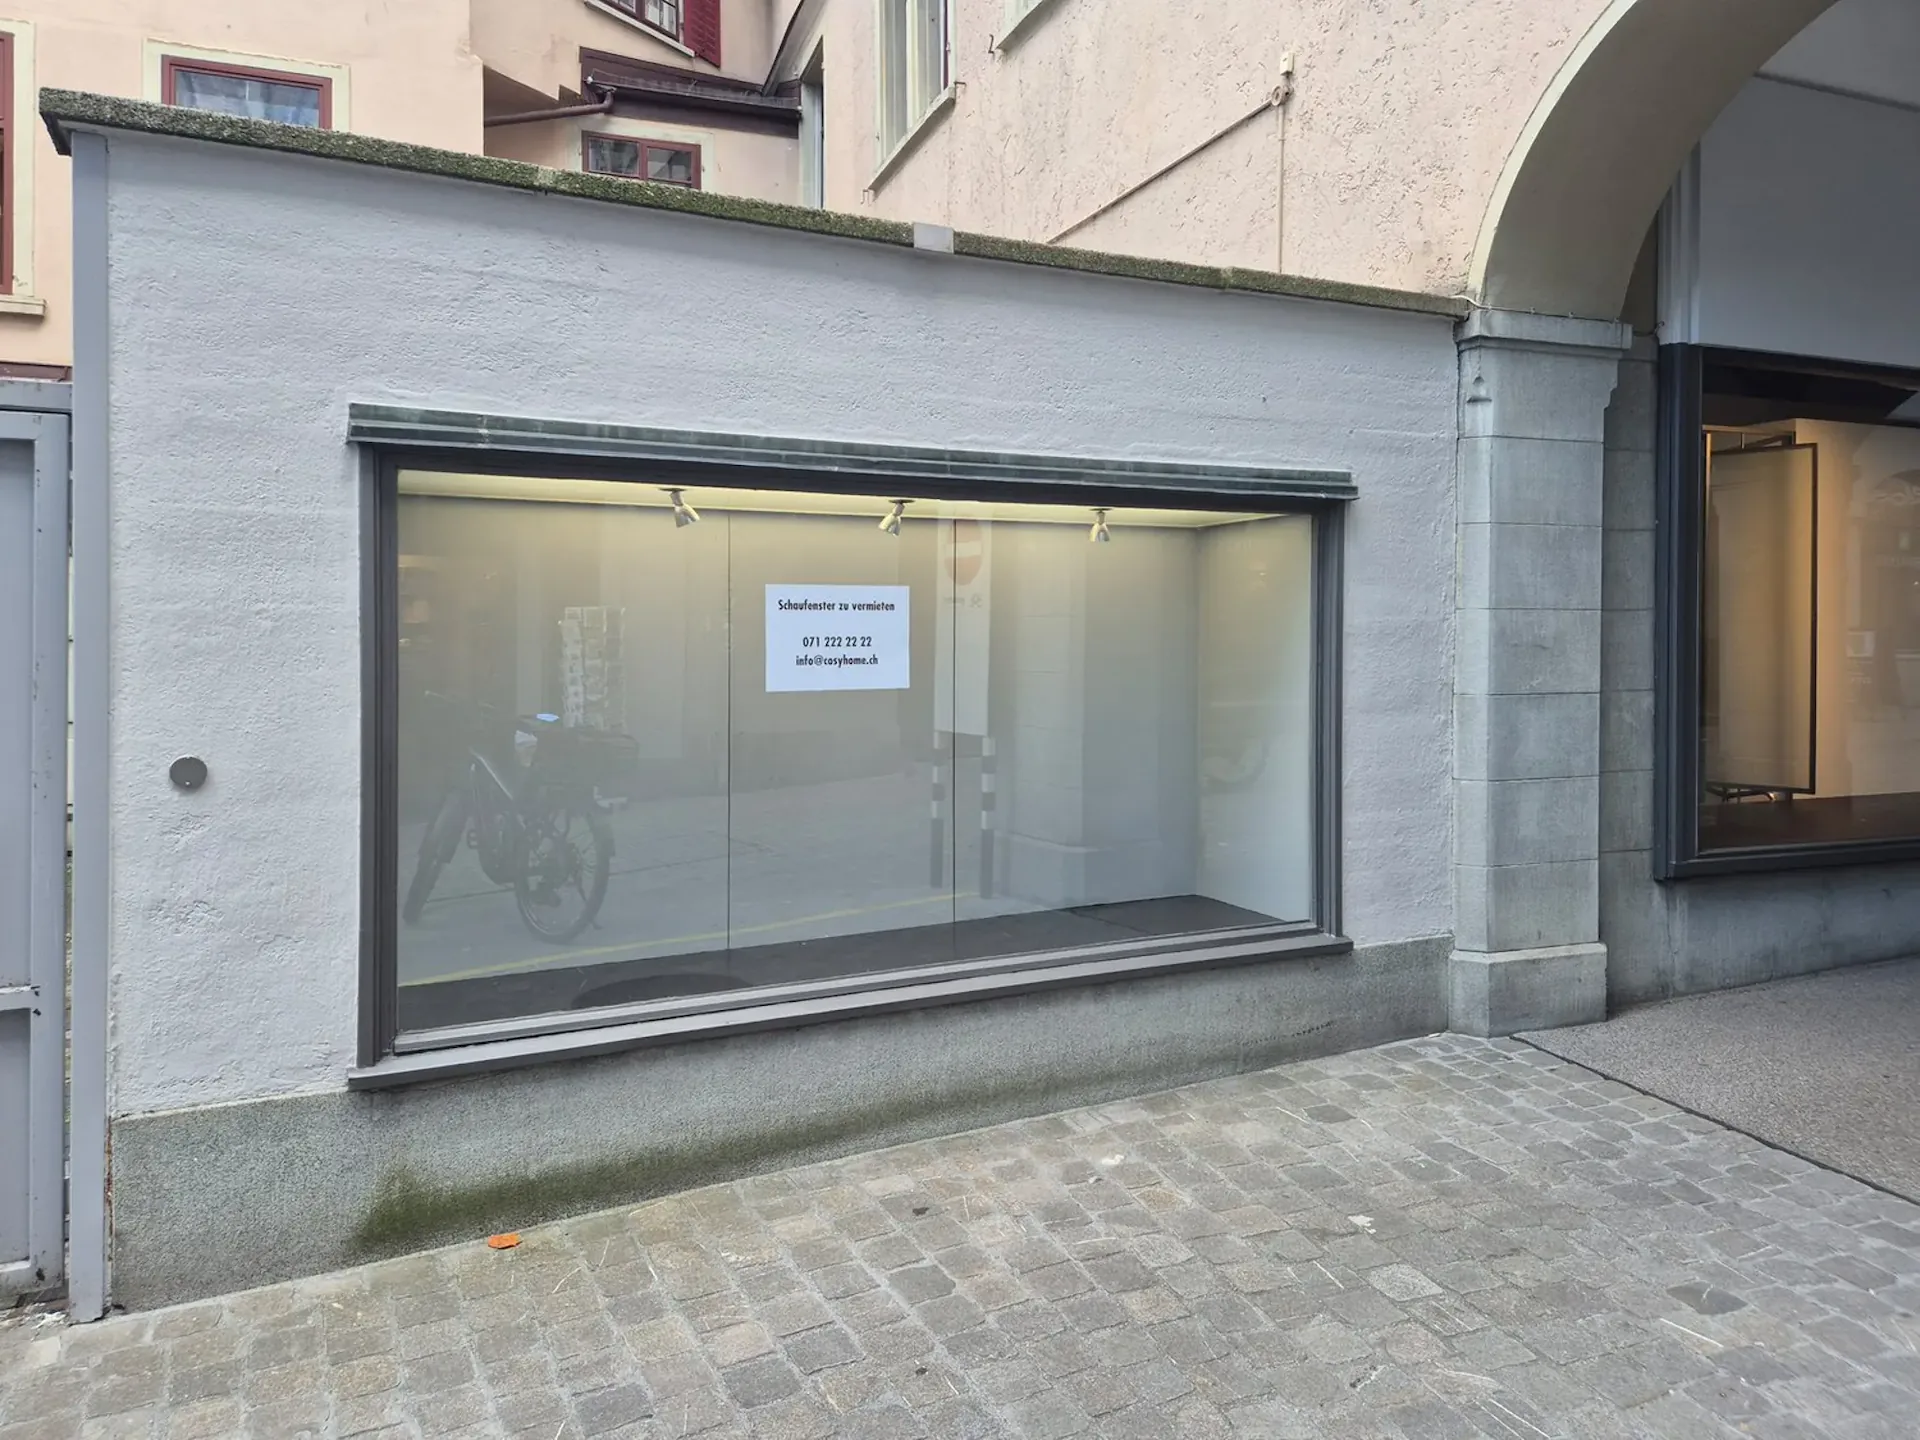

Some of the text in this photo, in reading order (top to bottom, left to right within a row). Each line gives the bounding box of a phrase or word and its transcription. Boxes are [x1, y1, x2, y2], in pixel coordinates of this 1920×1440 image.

[778, 599, 895, 611] Schaufenster zu vermieten
[803, 636, 872, 647] 071 222 22 22
[796, 654, 879, 668] info@cosyhome.ch
